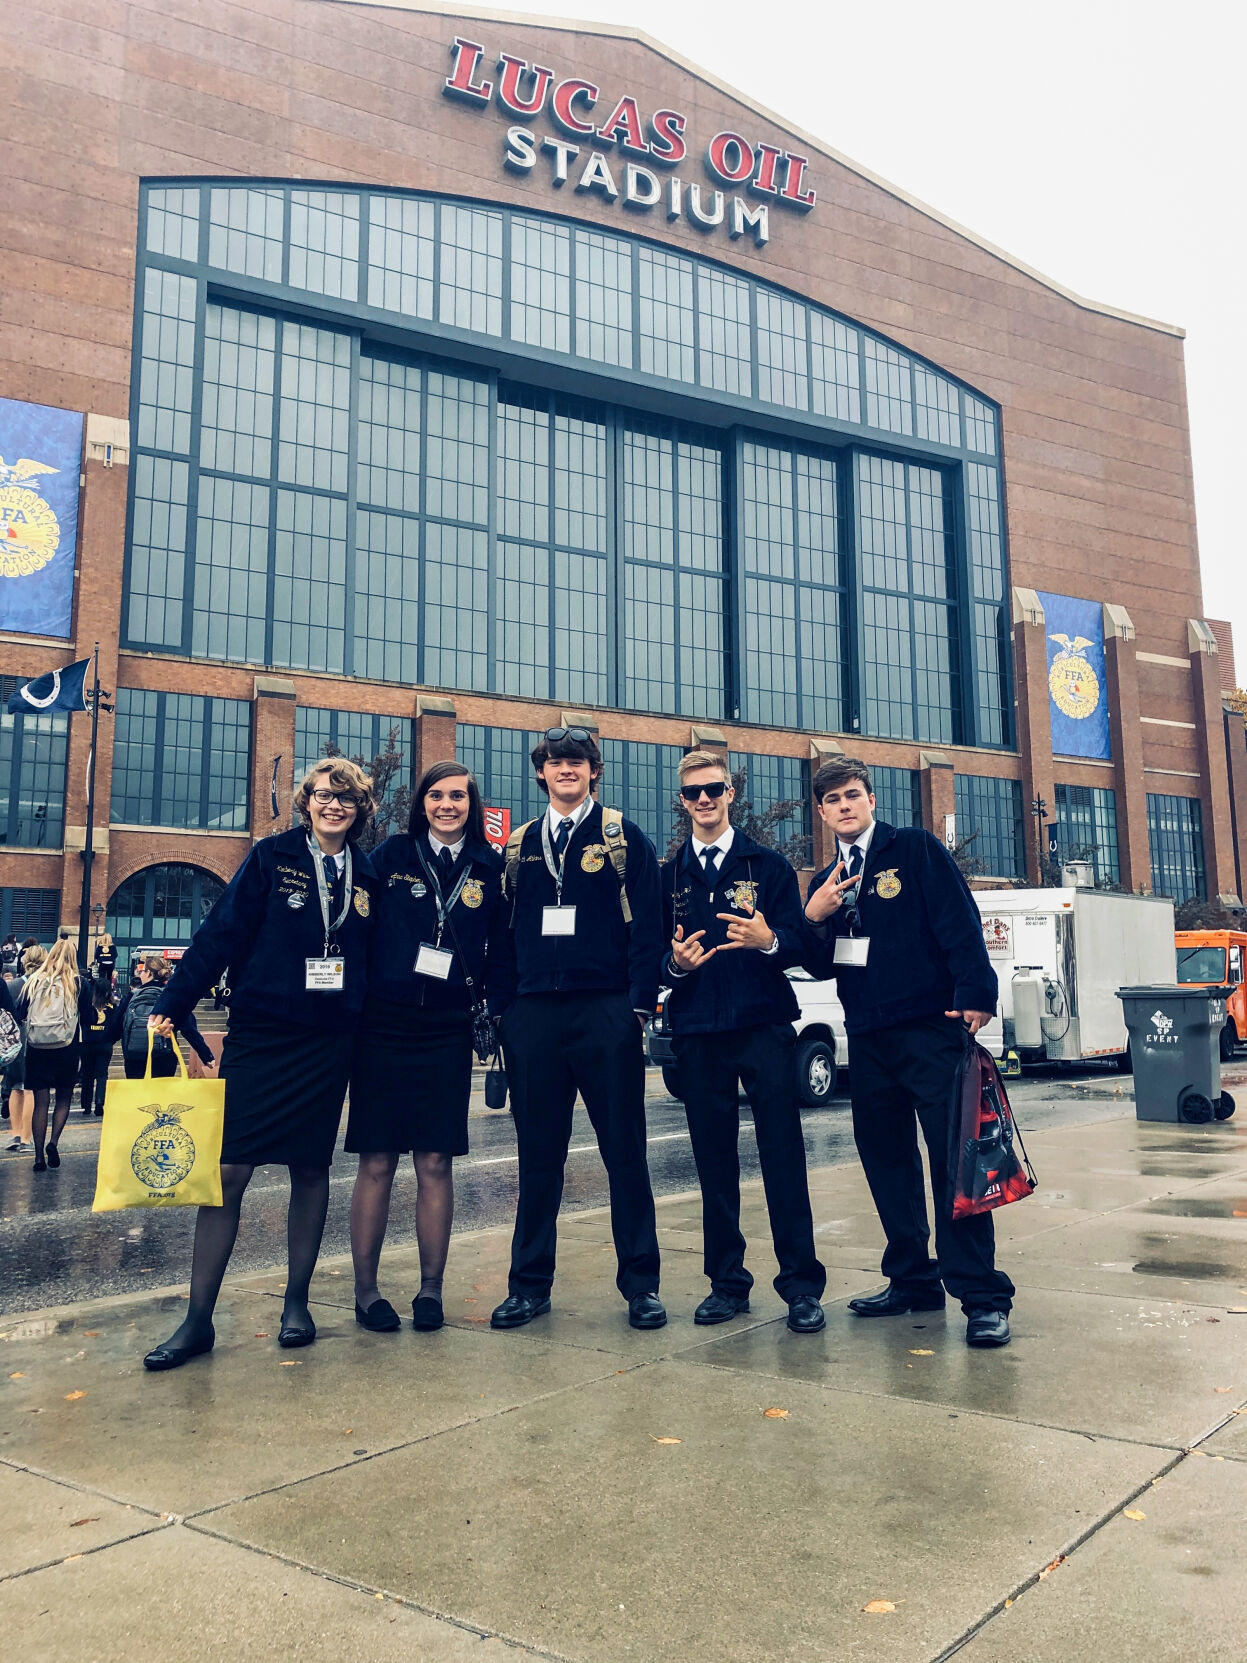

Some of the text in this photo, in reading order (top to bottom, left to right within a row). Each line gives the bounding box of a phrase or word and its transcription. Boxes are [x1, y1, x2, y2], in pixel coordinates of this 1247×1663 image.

[443, 36, 817, 210] LUCAS OIL
[504, 126, 770, 247] STADIUM
[0, 494, 44, 528] ULTURAL
[0, 507, 28, 524] FA
[2, 548, 36, 564] ATION
[1064, 670, 1084, 682] FFA
[982, 918, 993, 929] hef
[1146, 1034, 1179, 1043] EVENT
[143, 1131, 185, 1151] AGRICULTURAL
[153, 1139, 175, 1150] FFA
[144, 1165, 181, 1179] EDUCATION
